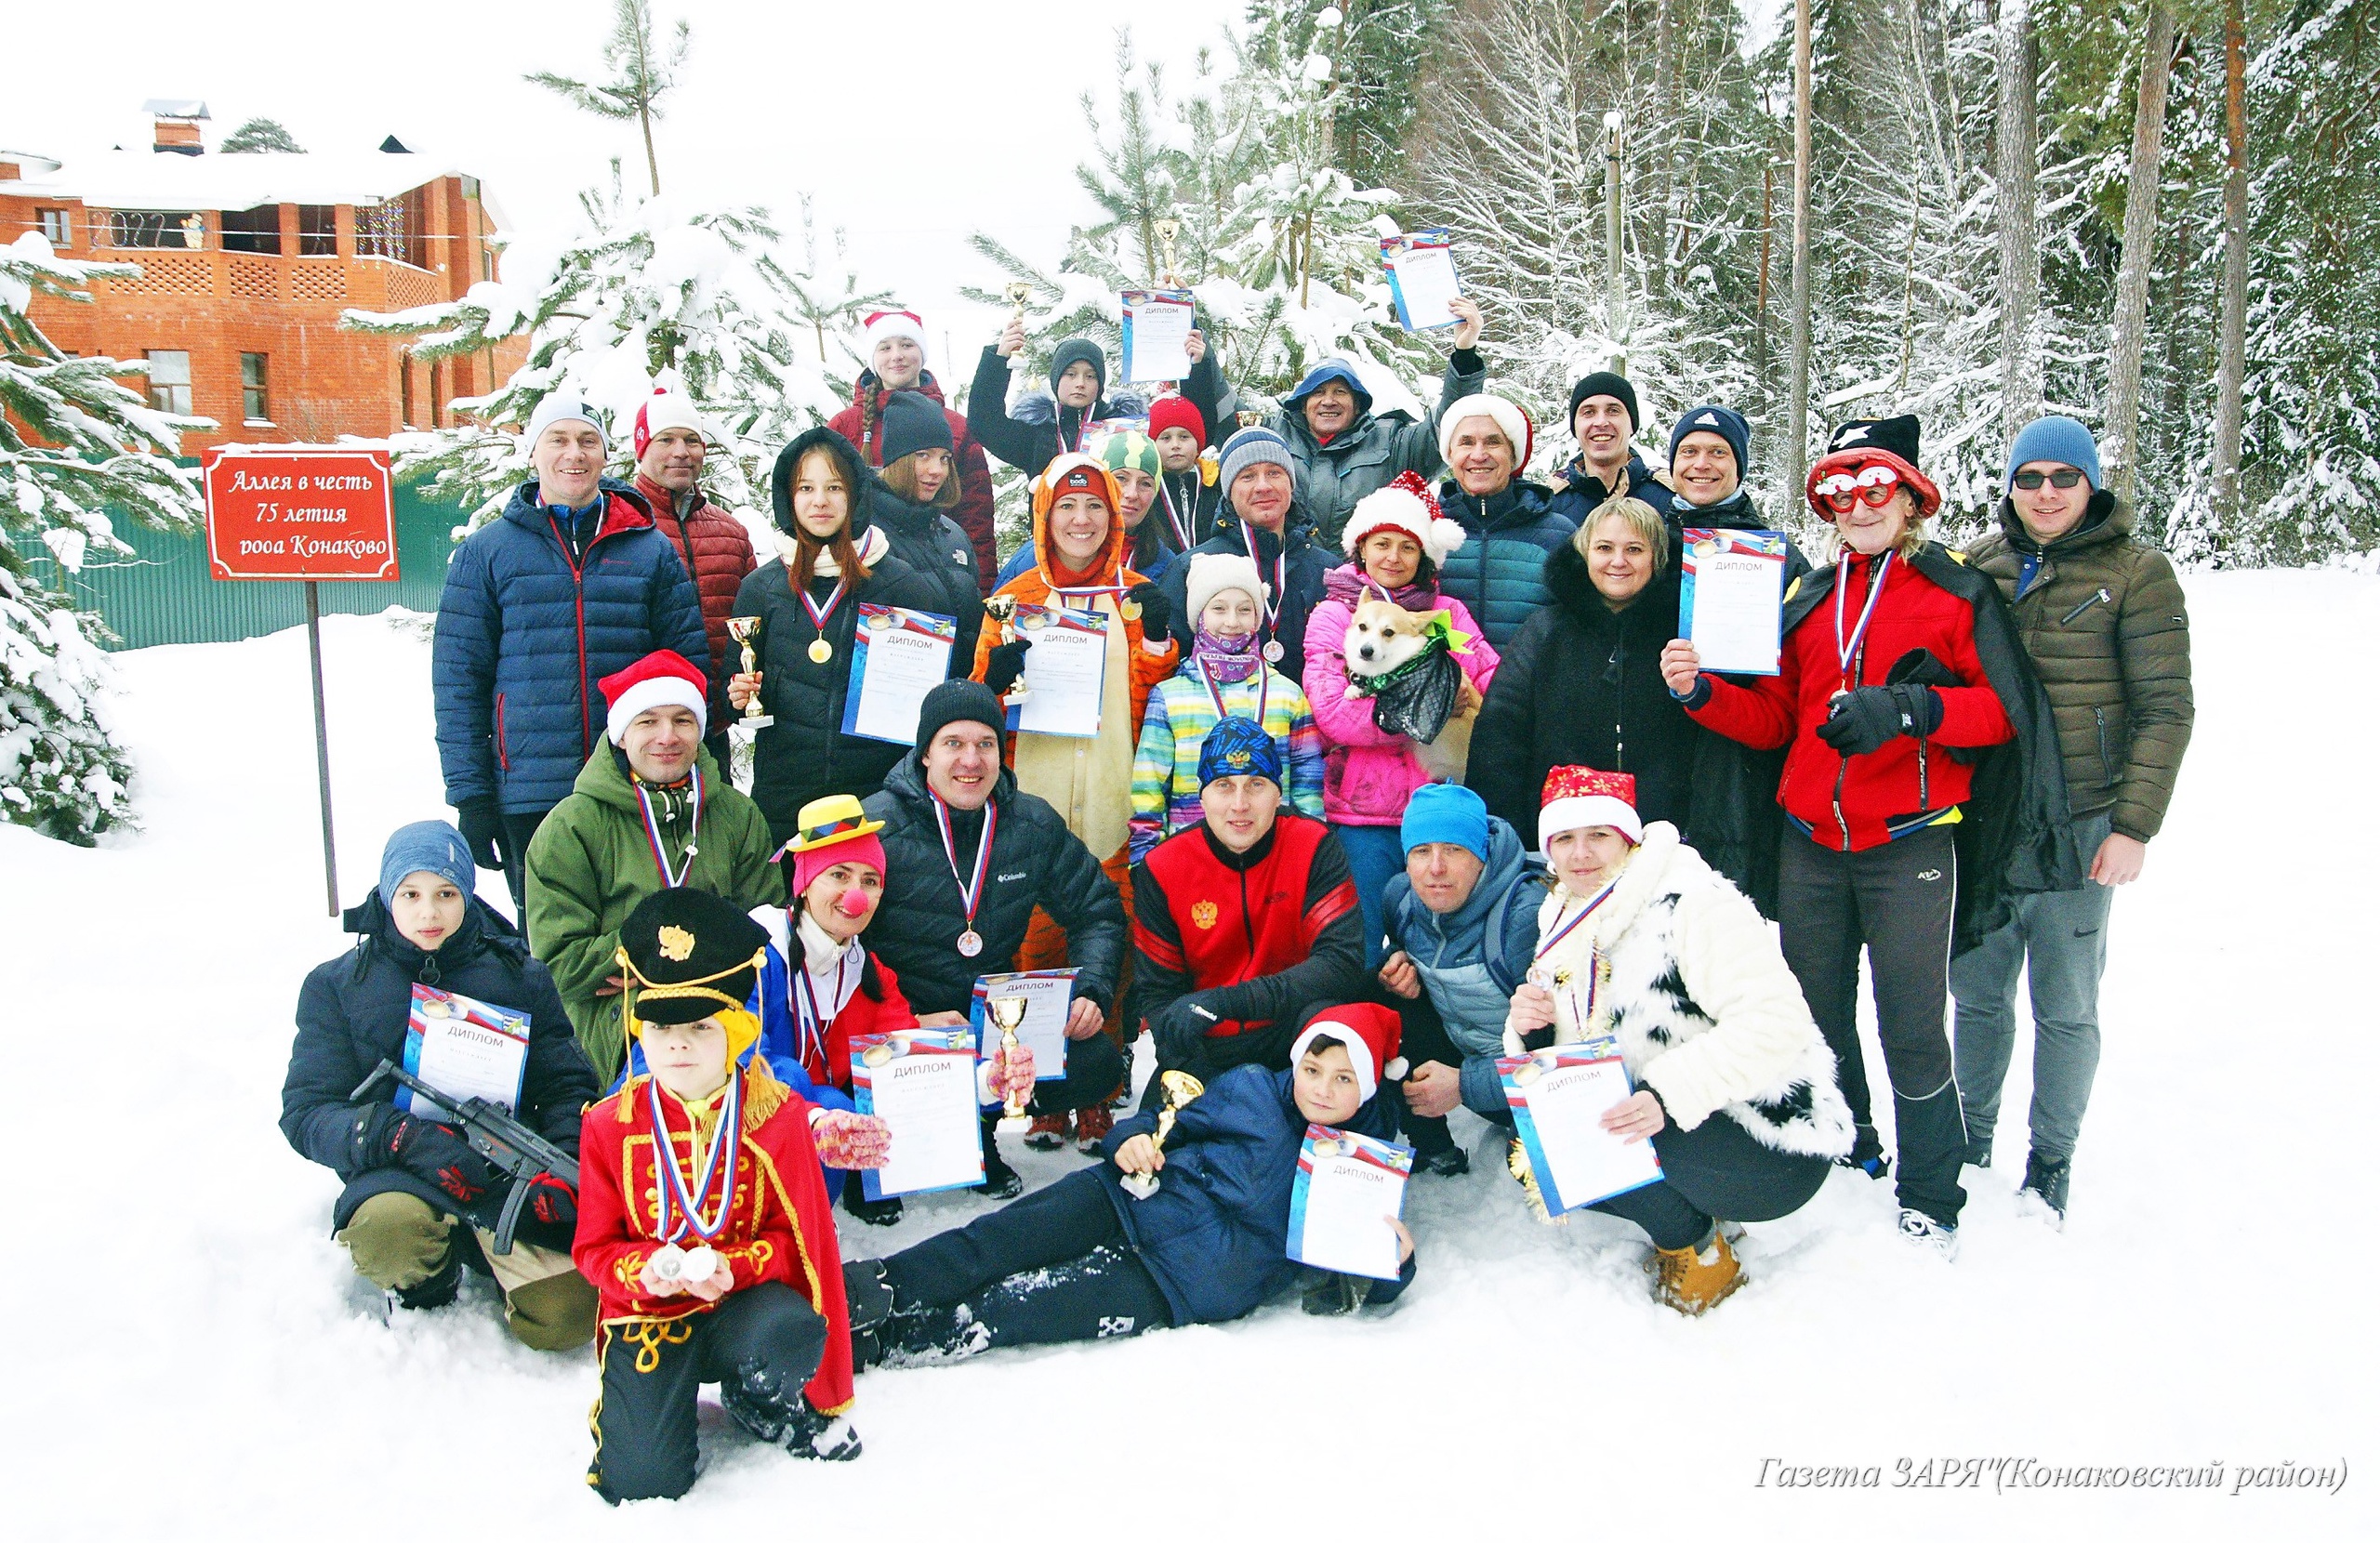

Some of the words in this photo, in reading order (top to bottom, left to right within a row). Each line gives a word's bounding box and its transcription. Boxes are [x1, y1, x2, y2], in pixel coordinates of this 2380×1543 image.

[1405, 252, 1437, 264] ДИПЛОМ
[1144, 307, 1180, 315] ДИПЛОМ
[228, 470, 293, 493] Аллея
[298, 476, 308, 491] в
[313, 475, 373, 491] честь
[256, 502, 279, 522] 75
[283, 508, 348, 523] летия
[290, 534, 387, 560] Конаково
[1714, 561, 1763, 571] ДИПЛОМ
[887, 635, 932, 650] ДИПЛОМ
[1043, 634, 1088, 644] ДИПЛОМ
[1005, 982, 1054, 993] ДИПЛОМ
[447, 1025, 504, 1048] ДИПЛОМ
[893, 1062, 951, 1079] ДИПЛОМ
[1547, 1070, 1601, 1093] ДИПЛОМ
[1333, 1165, 1384, 1183] ДИПЛОМ
